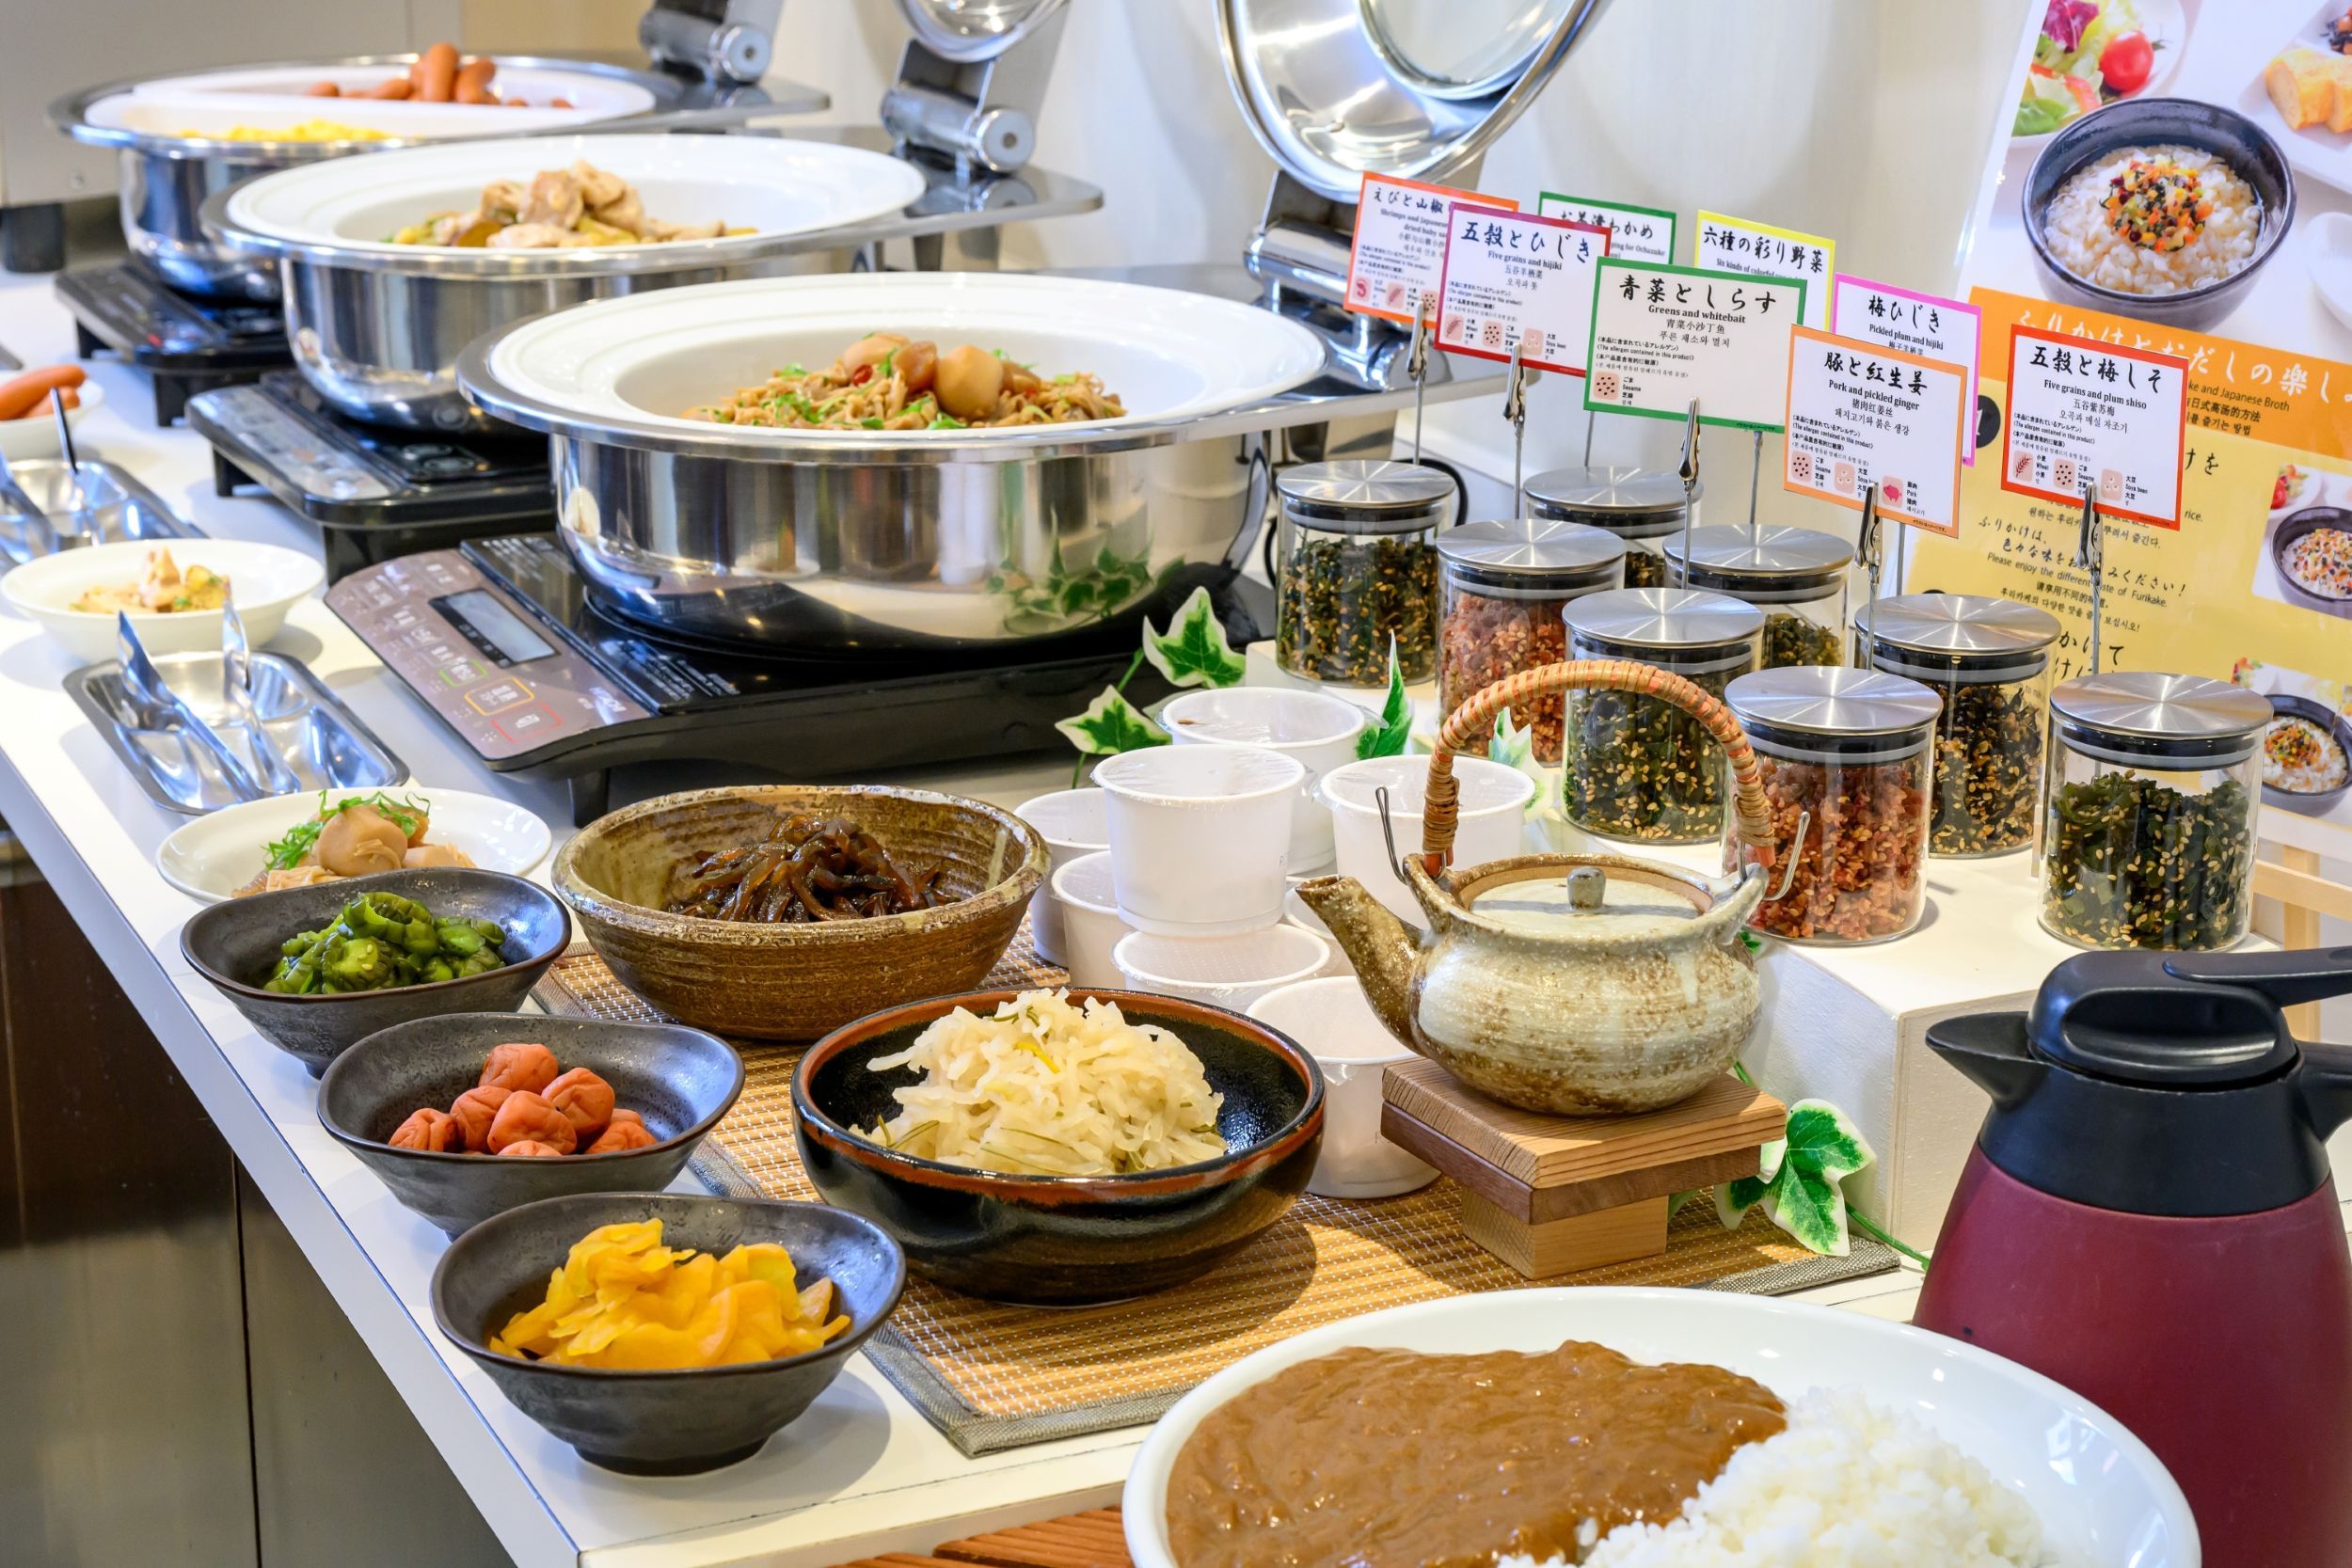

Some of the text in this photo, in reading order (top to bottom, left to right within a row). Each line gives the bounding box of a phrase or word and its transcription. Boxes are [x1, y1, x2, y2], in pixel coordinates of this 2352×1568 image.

[1461, 221, 1589, 263] 五穀とひじき
[1704, 226, 1822, 274] 六種の彩り野菜
[1488, 250, 1563, 271] Five grains and hijiki
[1726, 260, 1742, 271] kinds
[1619, 274, 1776, 314] 青菜としらす
[1648, 305, 1746, 324] Greens and whitebait
[1868, 294, 1939, 334] 梅ひじき
[1869, 324, 1944, 350] Pickled plum and hijiki
[1824, 351, 1928, 396] 豚と紅生姜
[2029, 345, 2161, 394] 五穀と梅しそ
[1829, 379, 1920, 411] Pork and pickled ginger
[2044, 379, 2147, 409] Five grains and plum shiso
[2201, 386, 2290, 412] and Japanese Broth
[1907, 489, 1916, 498] Pork
[1987, 552, 2012, 566] Please
[2015, 560, 2038, 576] enjoy
[2041, 564, 2054, 578] the
[2057, 570, 2091, 588] different
[2118, 587, 2127, 596] of
